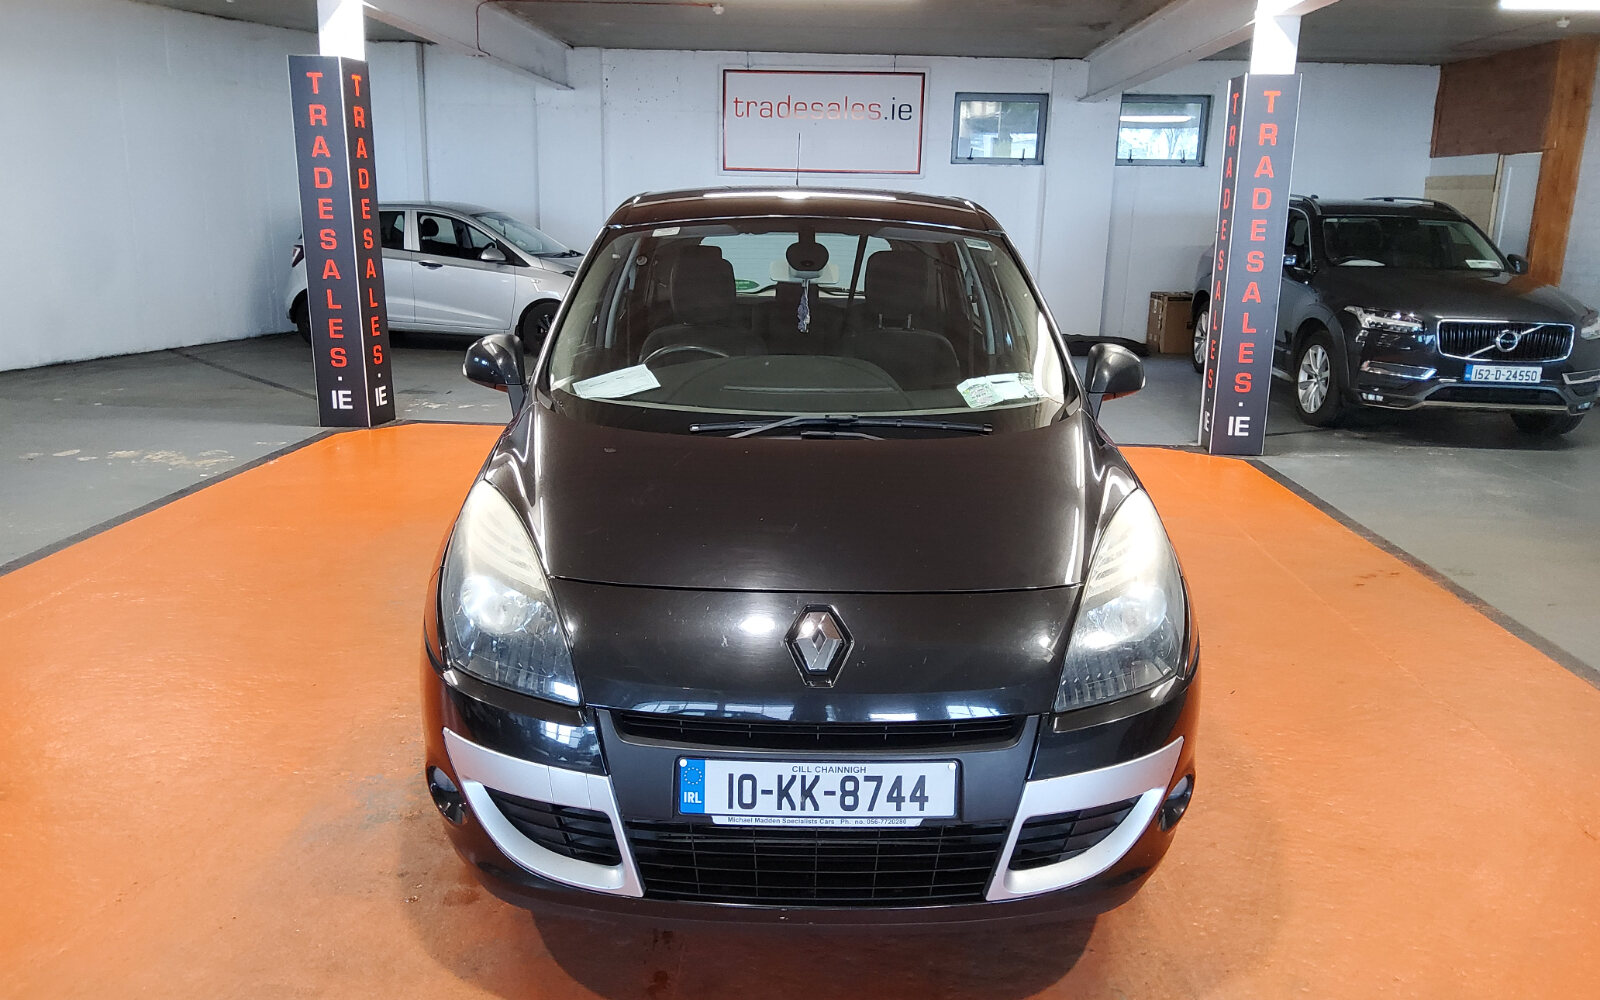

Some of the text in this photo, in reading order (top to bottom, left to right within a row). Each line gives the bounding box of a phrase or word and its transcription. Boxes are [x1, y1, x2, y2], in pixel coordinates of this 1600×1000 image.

[733, 94, 913, 121] tradesales.ie
[1474, 369, 1538, 381] 152-D-24550
[791, 765, 867, 774] CILL CHAINNIGH
[683, 791, 702, 804] IRL
[727, 773, 929, 812] 10-KK-8744
[727, 816, 753, 824] Michael
[782, 817, 818, 826] Specialists
